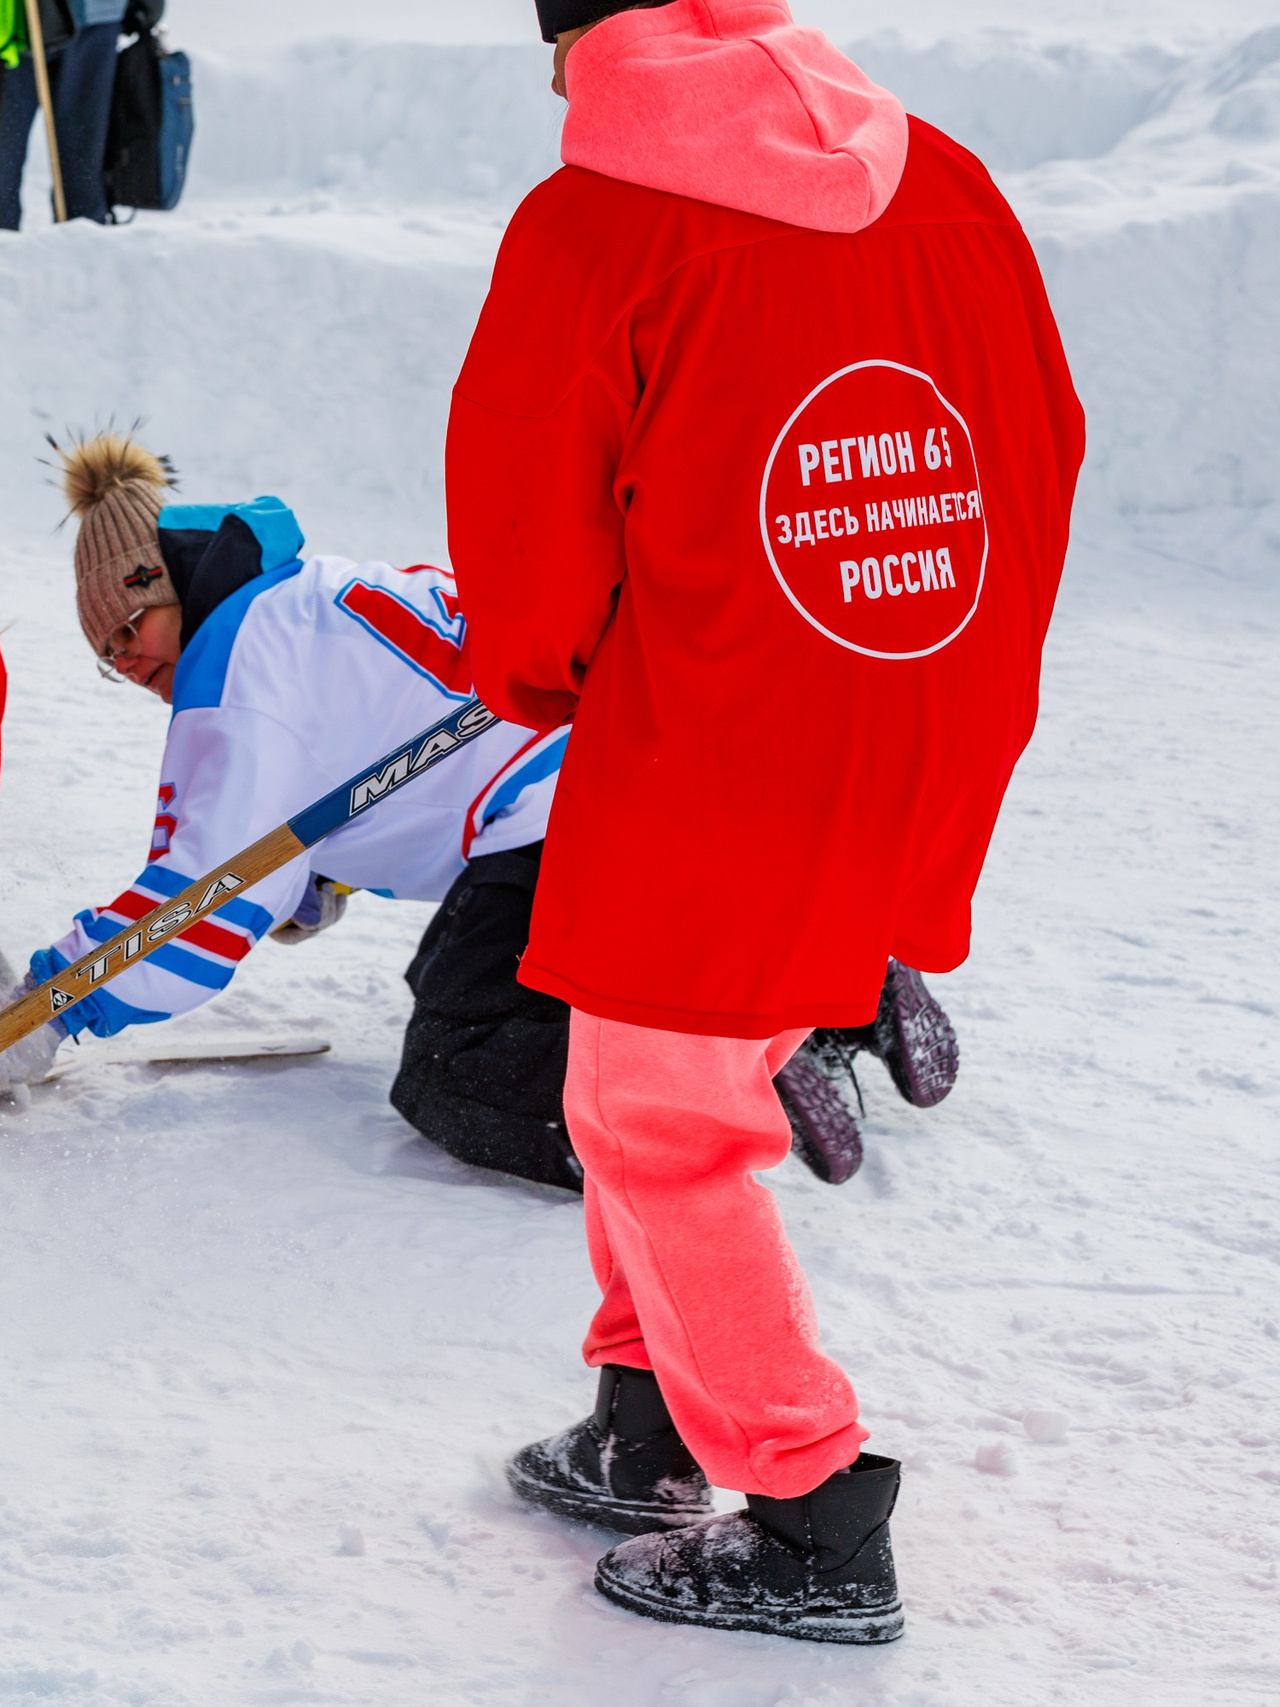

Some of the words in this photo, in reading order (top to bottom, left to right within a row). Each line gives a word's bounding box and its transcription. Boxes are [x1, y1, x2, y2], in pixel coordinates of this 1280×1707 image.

[798, 430, 916, 487] РЕГИОН
[775, 505, 860, 549] ЗДЕСЬ
[864, 489, 982, 533] НАЧИНАЕТСЯ
[839, 546, 957, 604] РОССИЯ
[75, 871, 247, 985] TISA
